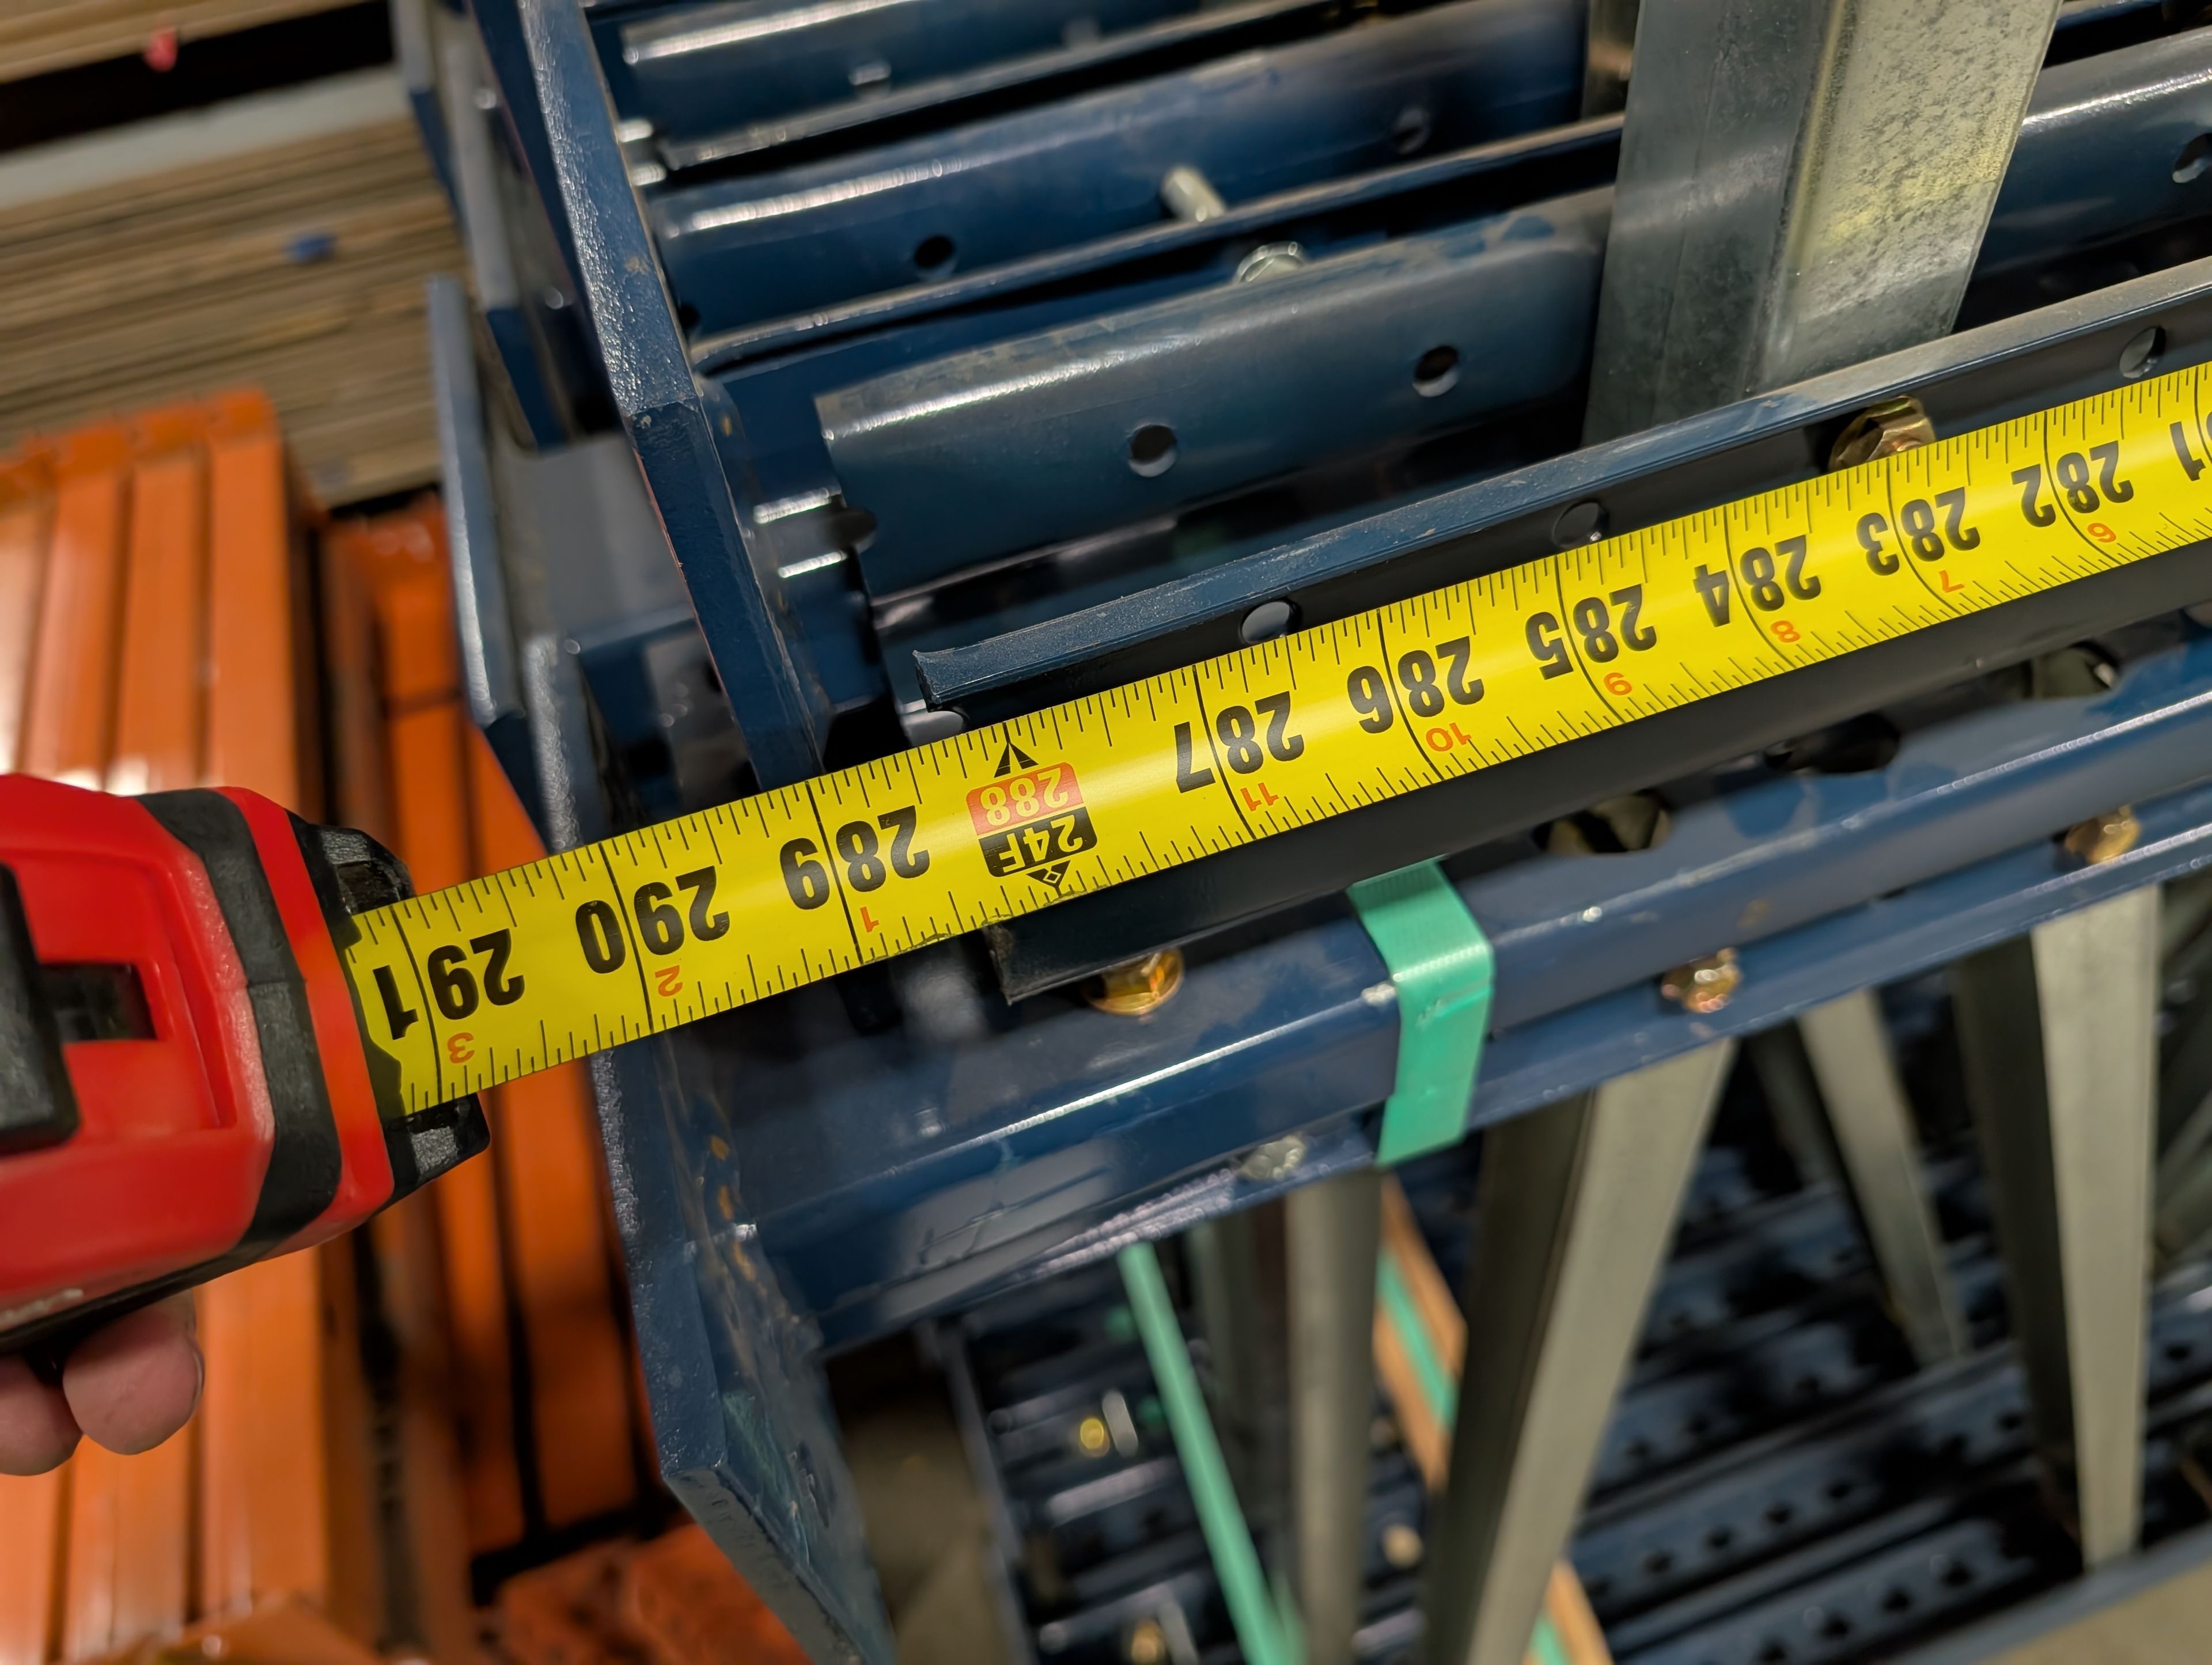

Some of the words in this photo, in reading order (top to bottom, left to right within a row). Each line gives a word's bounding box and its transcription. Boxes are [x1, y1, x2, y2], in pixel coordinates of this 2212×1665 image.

[2169, 411, 2212, 481] 1
[2011, 441, 2134, 528] 282
[1856, 487, 1980, 576] 283
[2087, 522, 2116, 543] 6
[1693, 534, 1821, 627] 284
[1938, 570, 1964, 593] 7
[1525, 583, 1657, 680] 285
[1770, 620, 1800, 643] 8
[1347, 636, 1484, 734] 286
[1603, 672, 1632, 696] 9
[1174, 691, 1304, 794] 287
[1426, 722, 1472, 752] 10
[979, 768, 1069, 826] 288
[1240, 782, 1279, 811] 11
[779, 805, 930, 910] 289
[994, 814, 1084, 873] 24F
[575, 866, 730, 974] 290
[860, 907, 879, 932] 1
[372, 928, 525, 1040] 291
[654, 965, 683, 997] 2
[447, 1032, 475, 1064] 3
